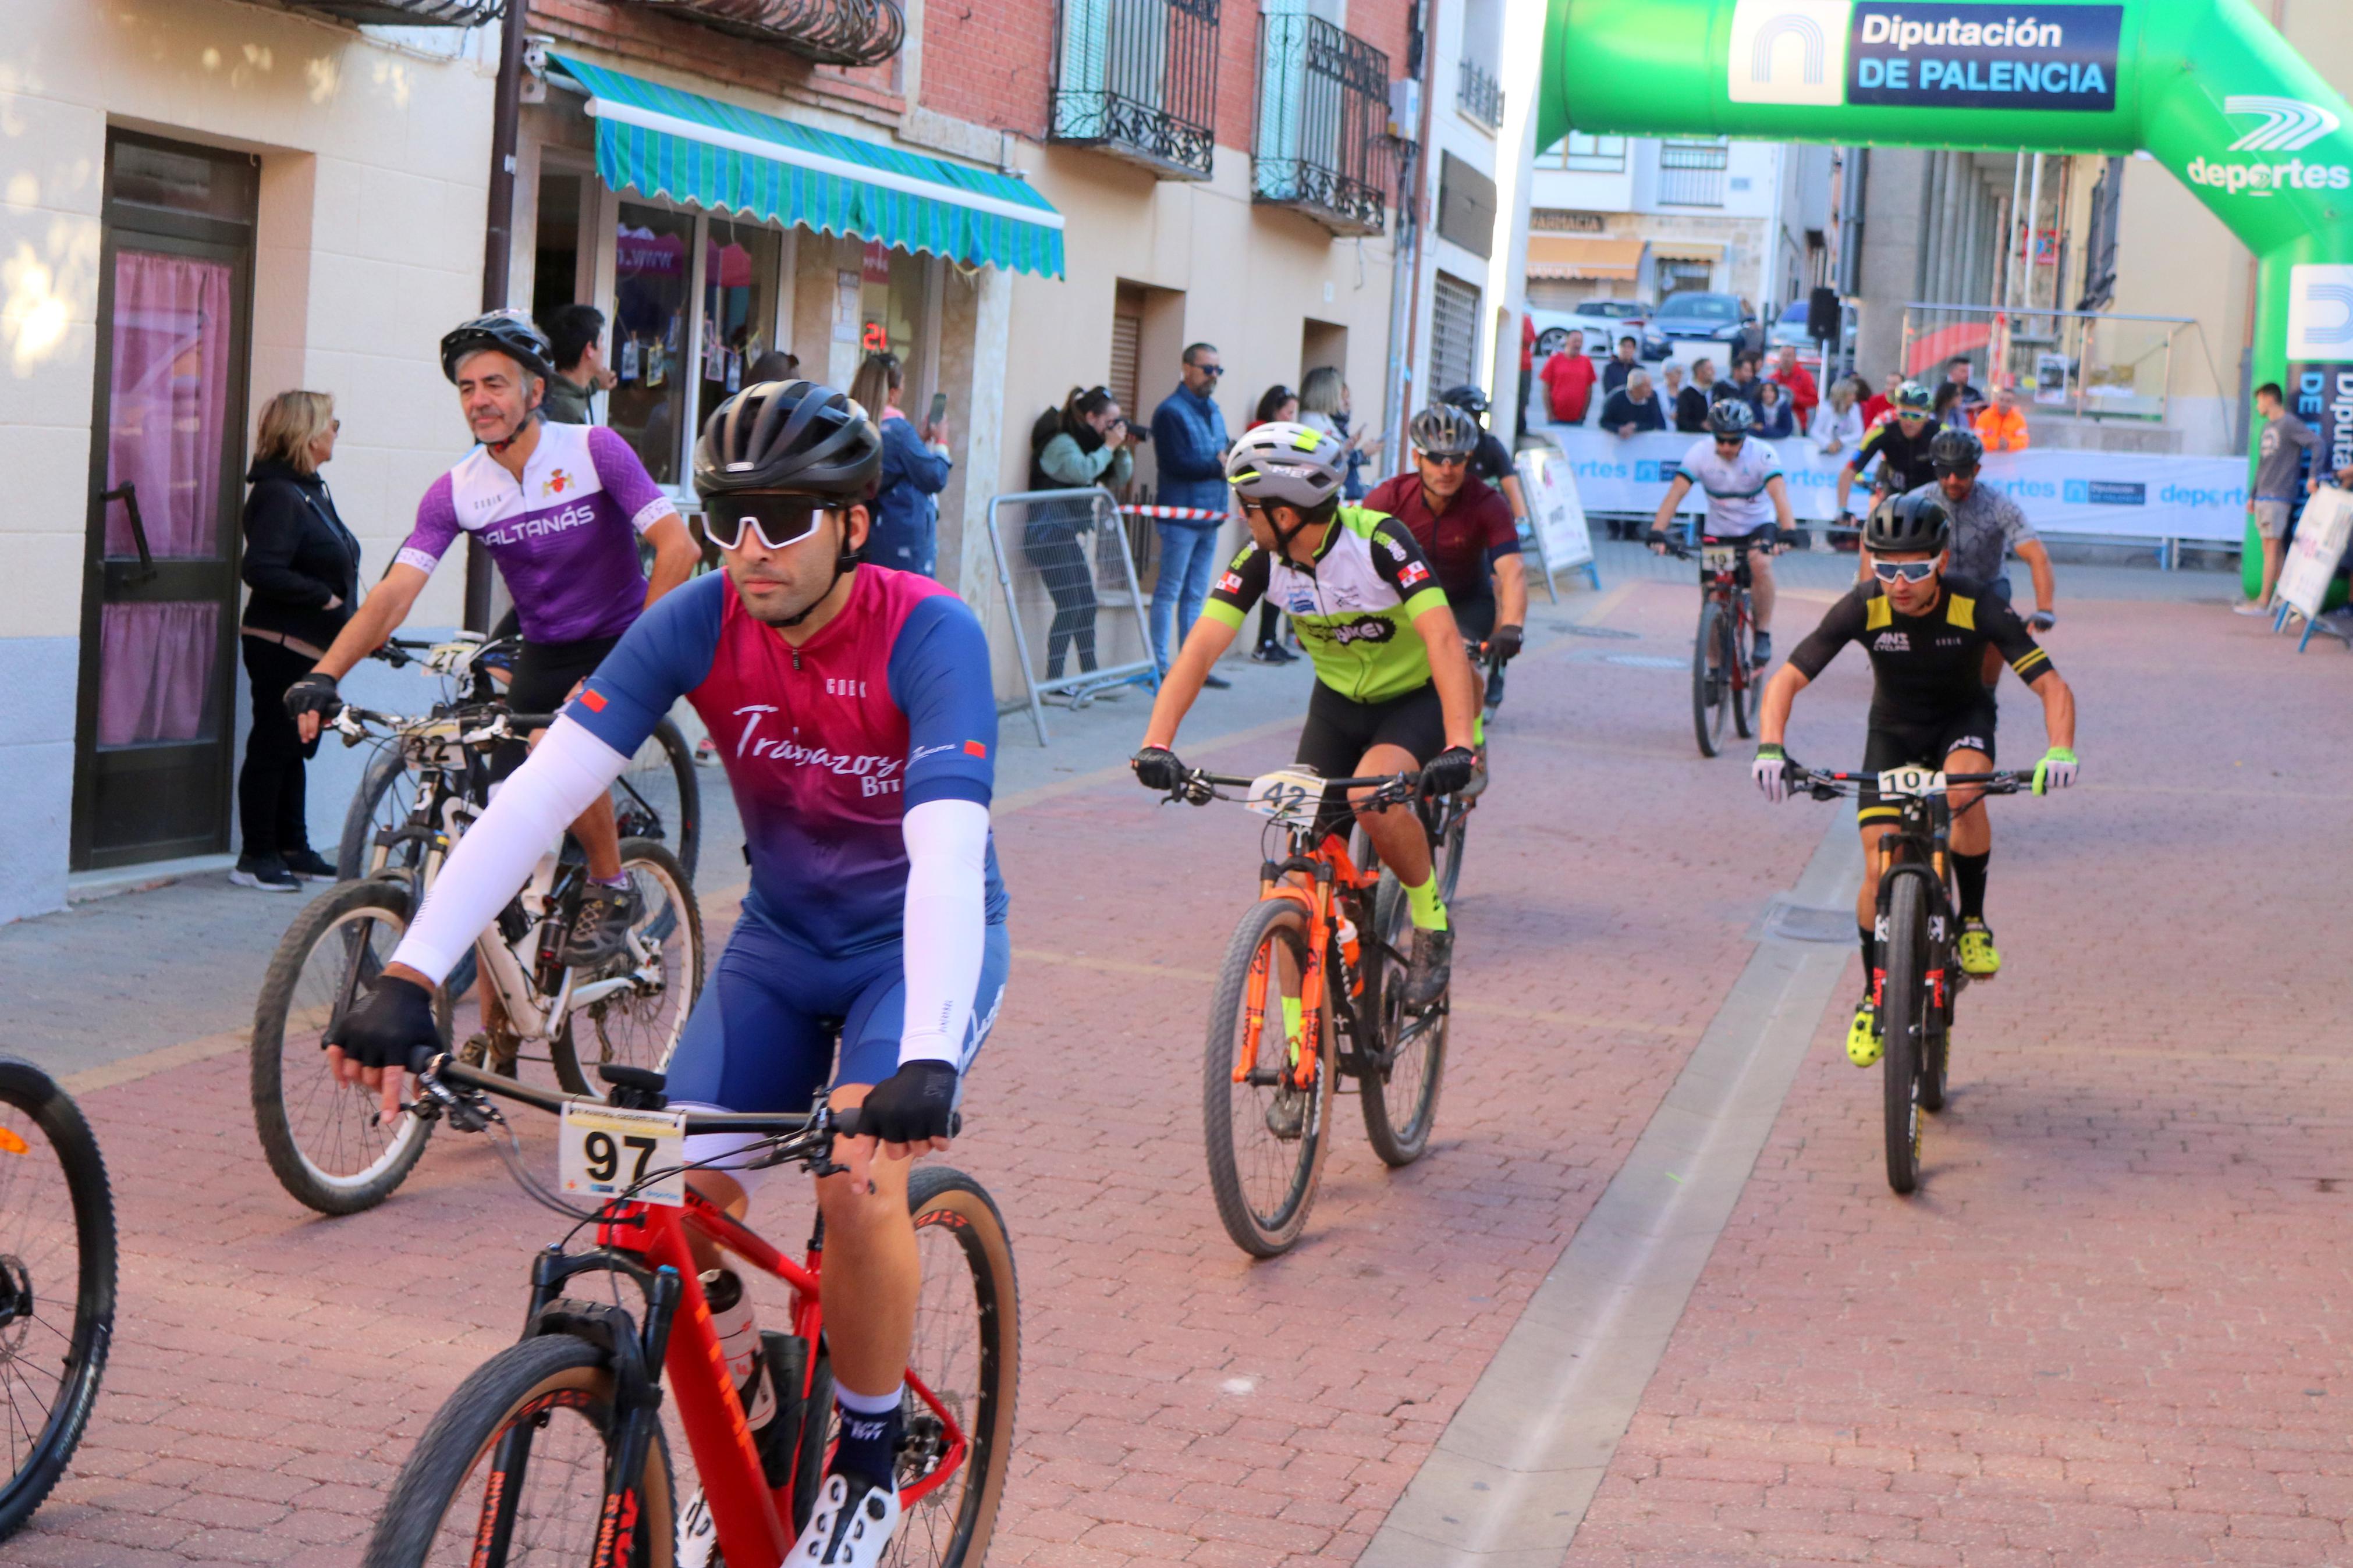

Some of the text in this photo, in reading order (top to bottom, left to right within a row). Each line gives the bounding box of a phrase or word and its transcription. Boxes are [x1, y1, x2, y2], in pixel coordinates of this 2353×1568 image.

[1861, 14, 2063, 51] Diputación
[1858, 58, 2108, 94] DE PALENCIA
[2187, 156, 2350, 195] deportes
[2299, 372, 2324, 414] DE
[1876, 632, 1908, 645] ANS
[431, 650, 460, 669] 27
[1263, 781, 1306, 813] 42
[1883, 771, 1938, 792] 107
[585, 1132, 657, 1184] 97
